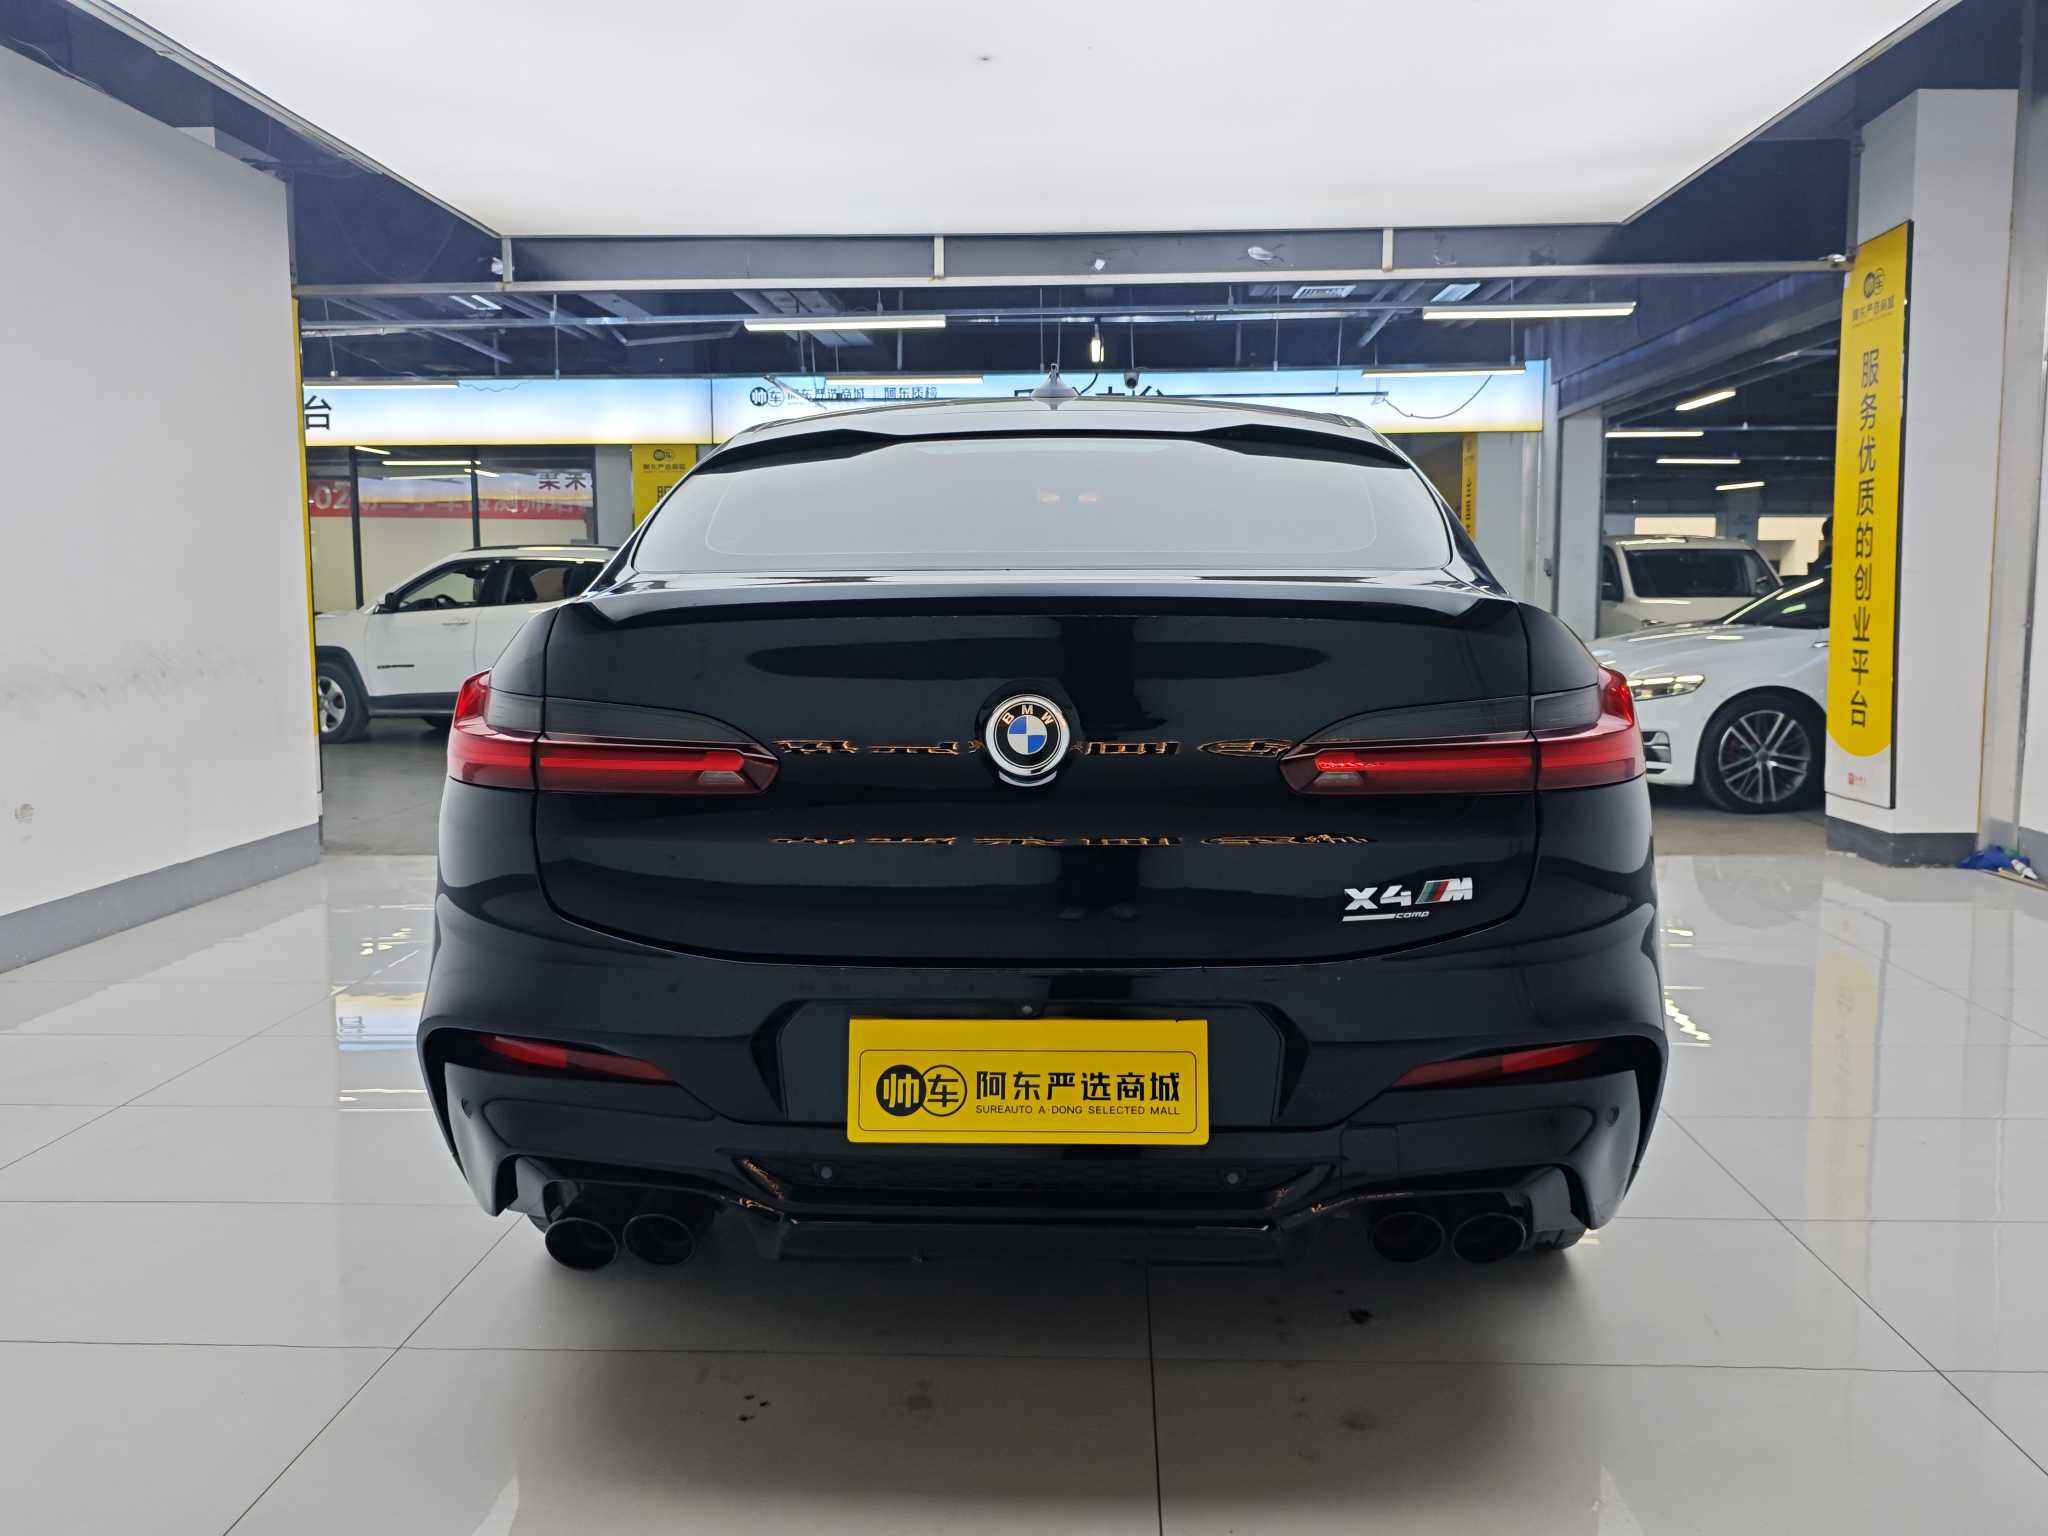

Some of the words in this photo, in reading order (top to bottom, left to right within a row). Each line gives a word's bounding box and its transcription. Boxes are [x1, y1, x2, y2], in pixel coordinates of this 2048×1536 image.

[305, 395, 332, 430] 台
[1851, 348, 1880, 728] 服务优质的创业平台
[1002, 704, 1055, 726] BMW
[1343, 884, 1412, 911] X4
[881, 1071, 961, 1110] 帅车
[976, 1071, 1180, 1102] 阿东严选商城
[975, 1104, 1033, 1114] SUREAUTO
[1087, 1105, 1146, 1115] SELECTED
[1150, 1106, 1180, 1116] MALL
